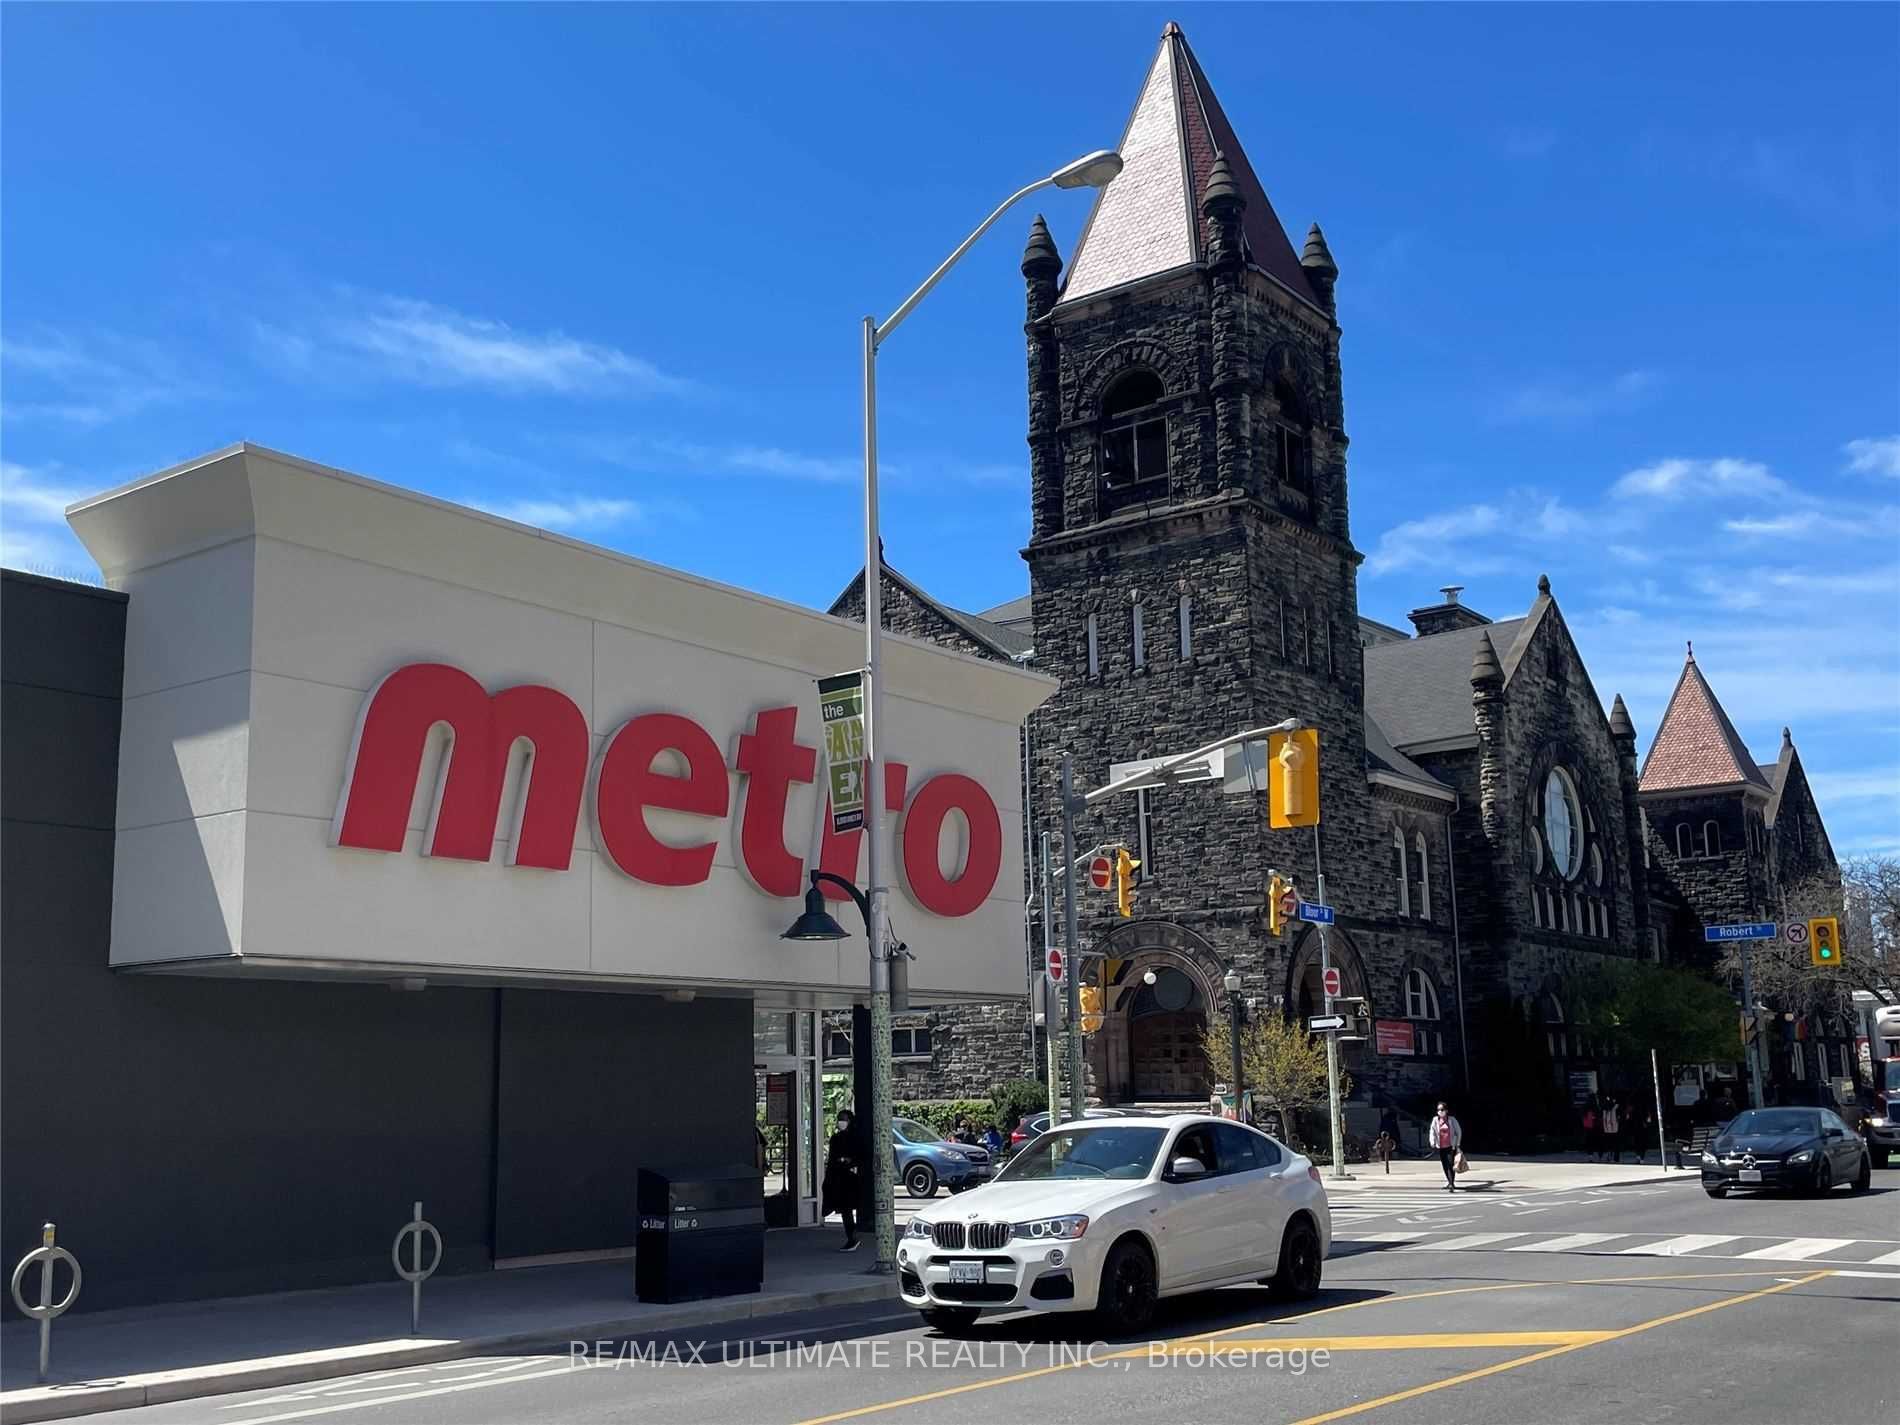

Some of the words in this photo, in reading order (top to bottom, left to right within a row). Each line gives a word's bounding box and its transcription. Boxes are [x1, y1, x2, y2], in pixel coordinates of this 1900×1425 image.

[823, 703, 845, 720] the
[333, 662, 1002, 918] metro
[1719, 926, 1753, 937] Robert
[674, 1218, 689, 1229] Litter
